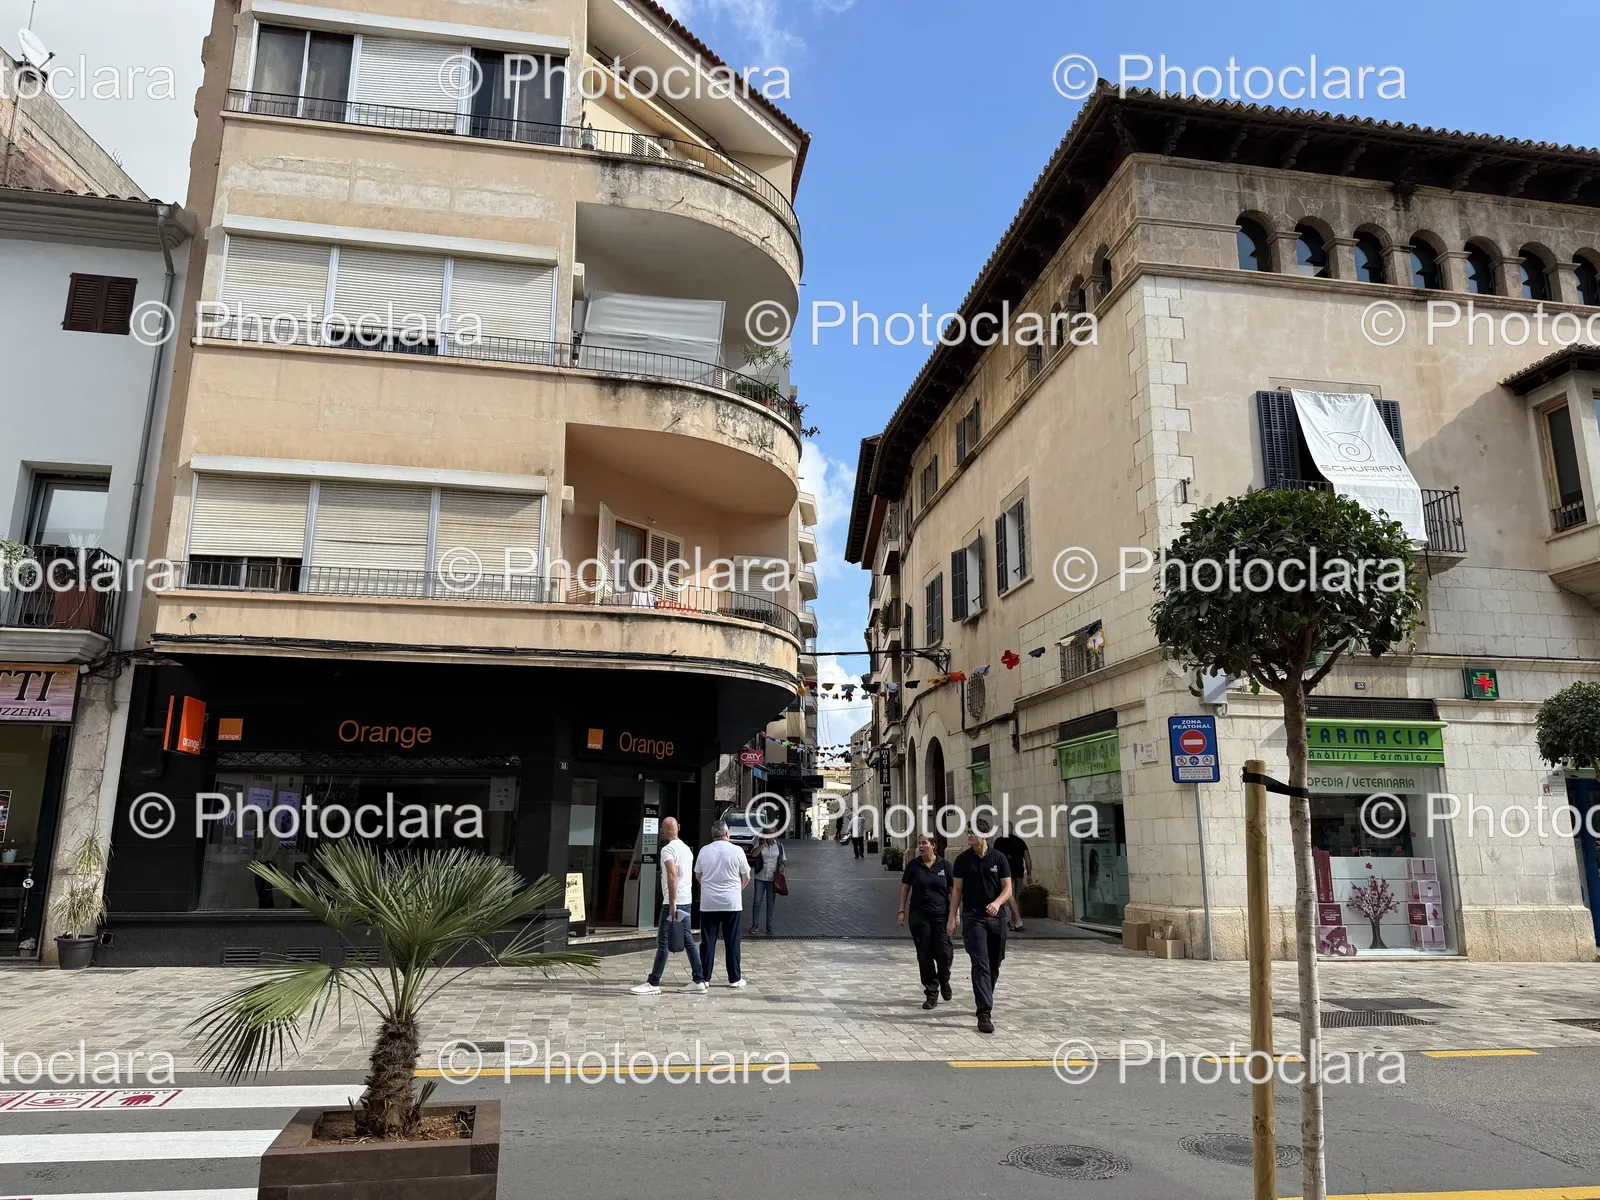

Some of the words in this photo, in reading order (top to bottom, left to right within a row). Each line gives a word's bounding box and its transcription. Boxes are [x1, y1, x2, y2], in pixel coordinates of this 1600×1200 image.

[1320, 464, 1402, 472] SCHURIAN
[338, 720, 432, 748] Orange
[182, 737, 200, 751] orange
[619, 732, 674, 760] Orange
[740, 752, 762, 761] CATY
[1352, 777, 1414, 788] VETERINARIA
